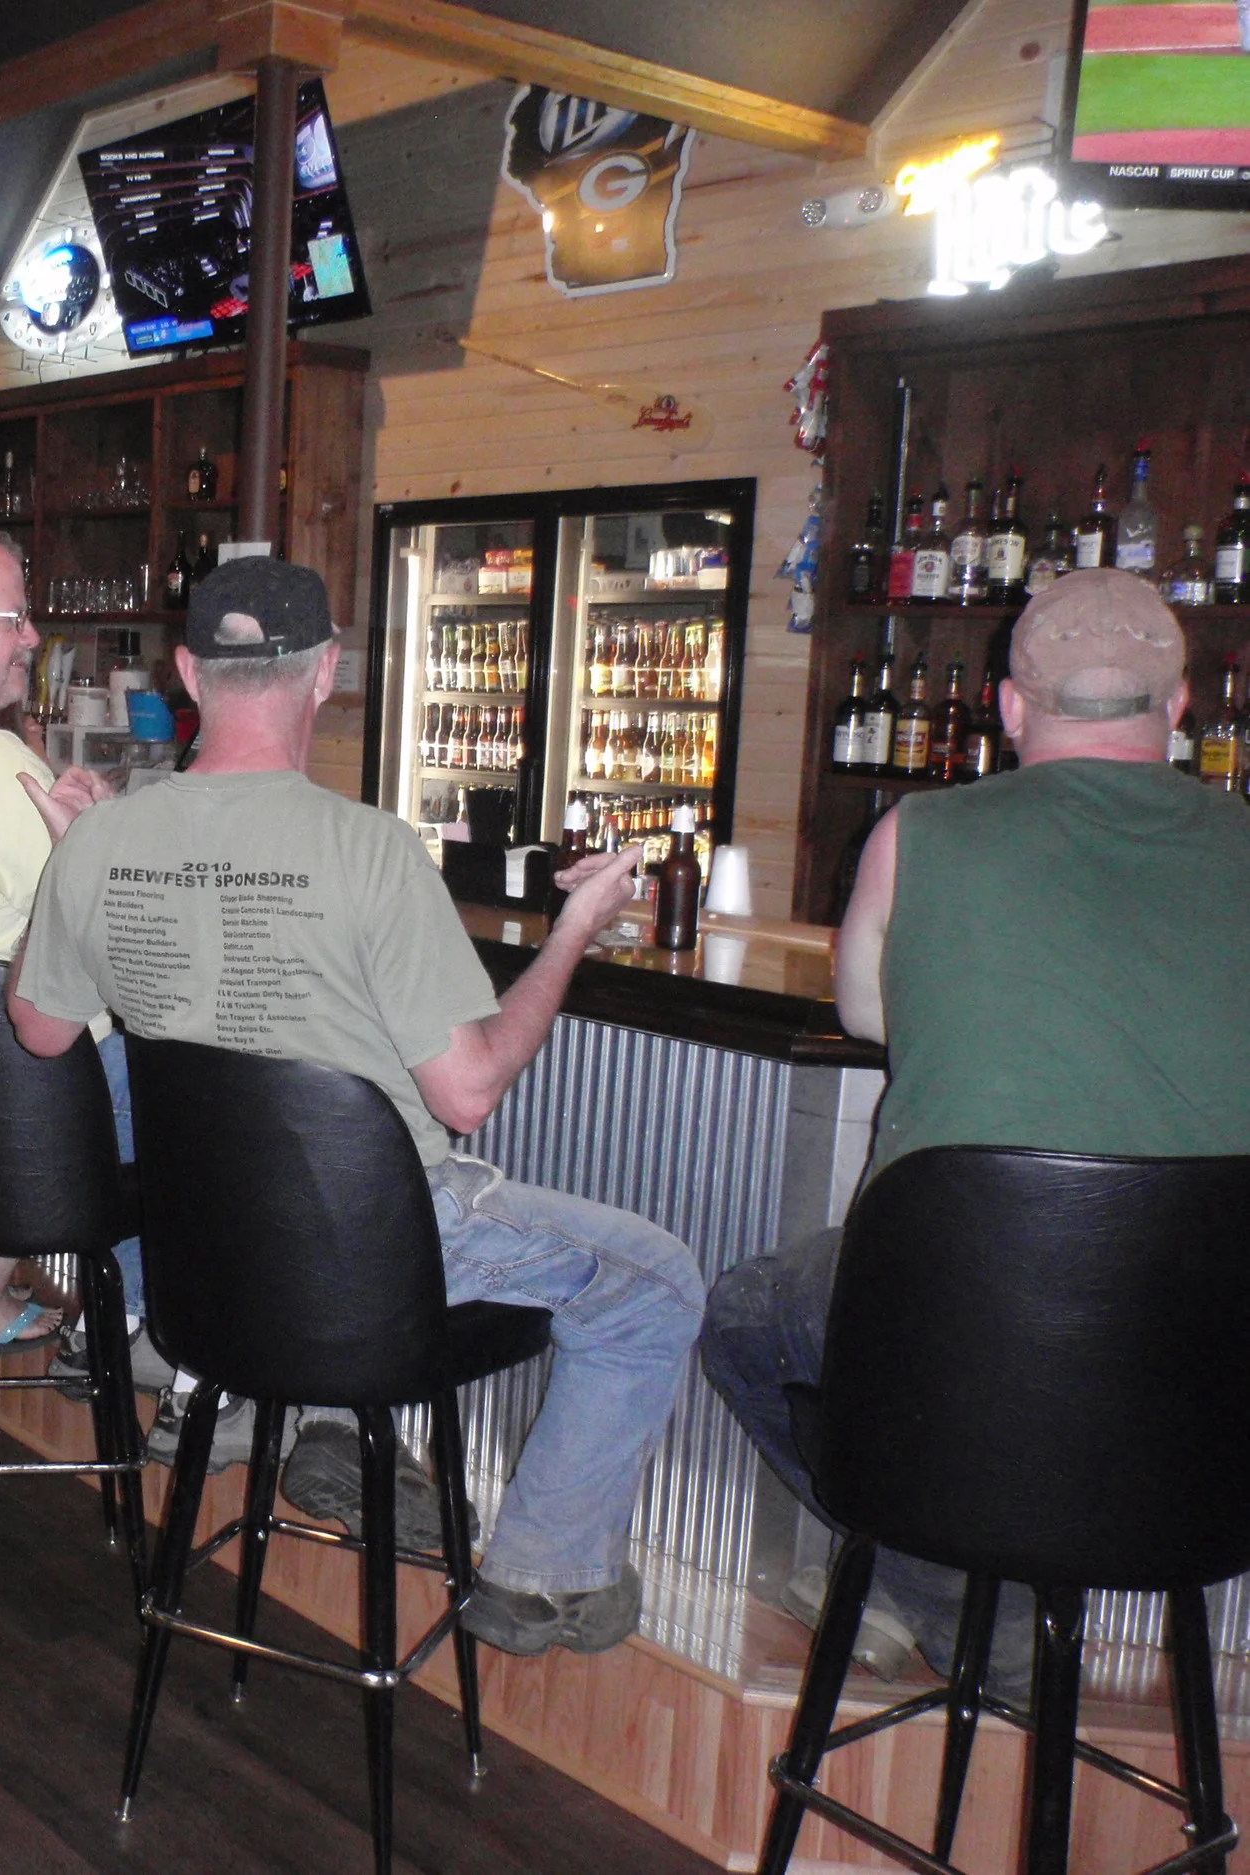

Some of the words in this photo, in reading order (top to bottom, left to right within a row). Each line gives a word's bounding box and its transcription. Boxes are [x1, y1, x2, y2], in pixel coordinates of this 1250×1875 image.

[1109, 165, 1159, 178] NASCAR
[1170, 168, 1209, 179] SPRINT
[1211, 169, 1234, 179] CUP
[181, 862, 232, 872] 2010
[109, 867, 209, 888] BREWFEST
[214, 872, 310, 889] SPONSORS
